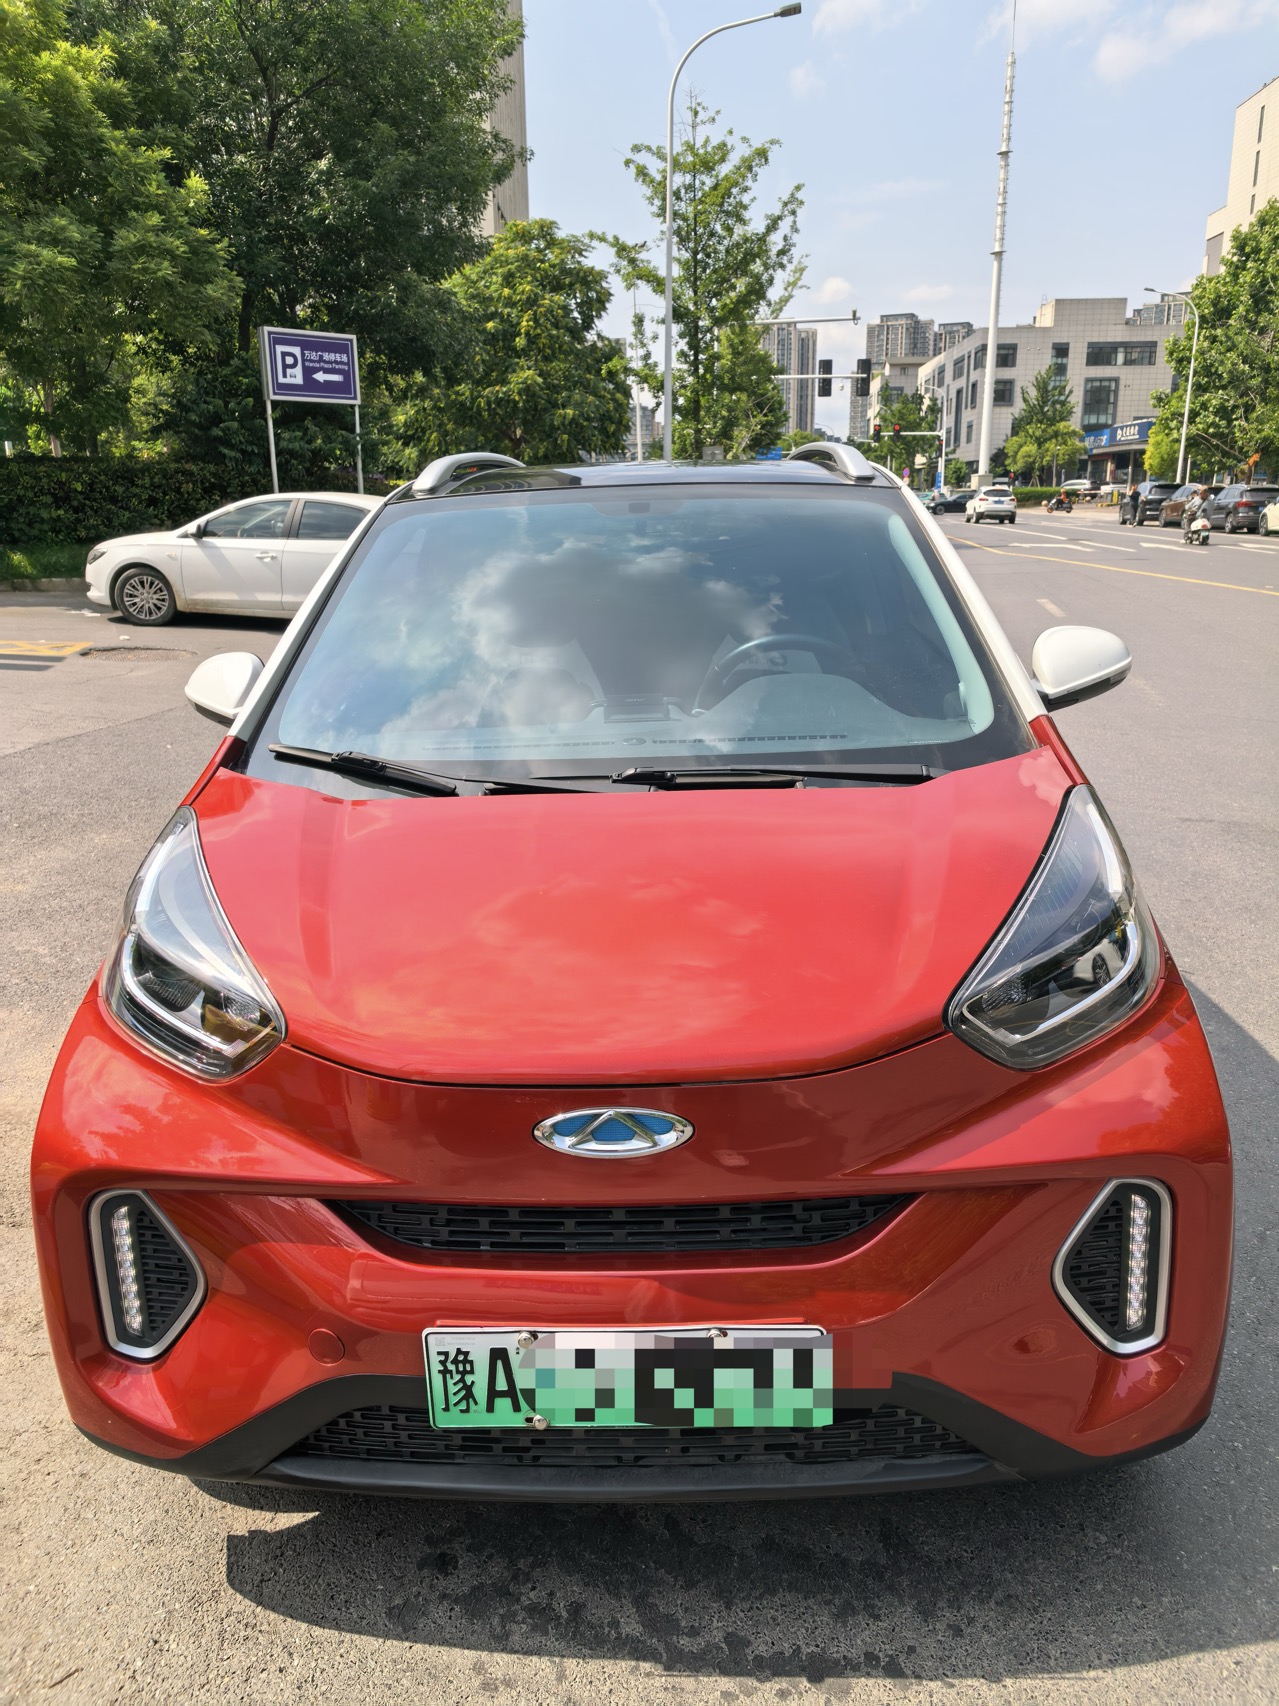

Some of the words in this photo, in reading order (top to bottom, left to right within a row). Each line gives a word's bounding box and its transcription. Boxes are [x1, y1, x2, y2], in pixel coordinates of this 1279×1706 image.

[304, 351, 348, 362] 万达广场停车场
[281, 351, 299, 378] P
[332, 363, 348, 371] Parking
